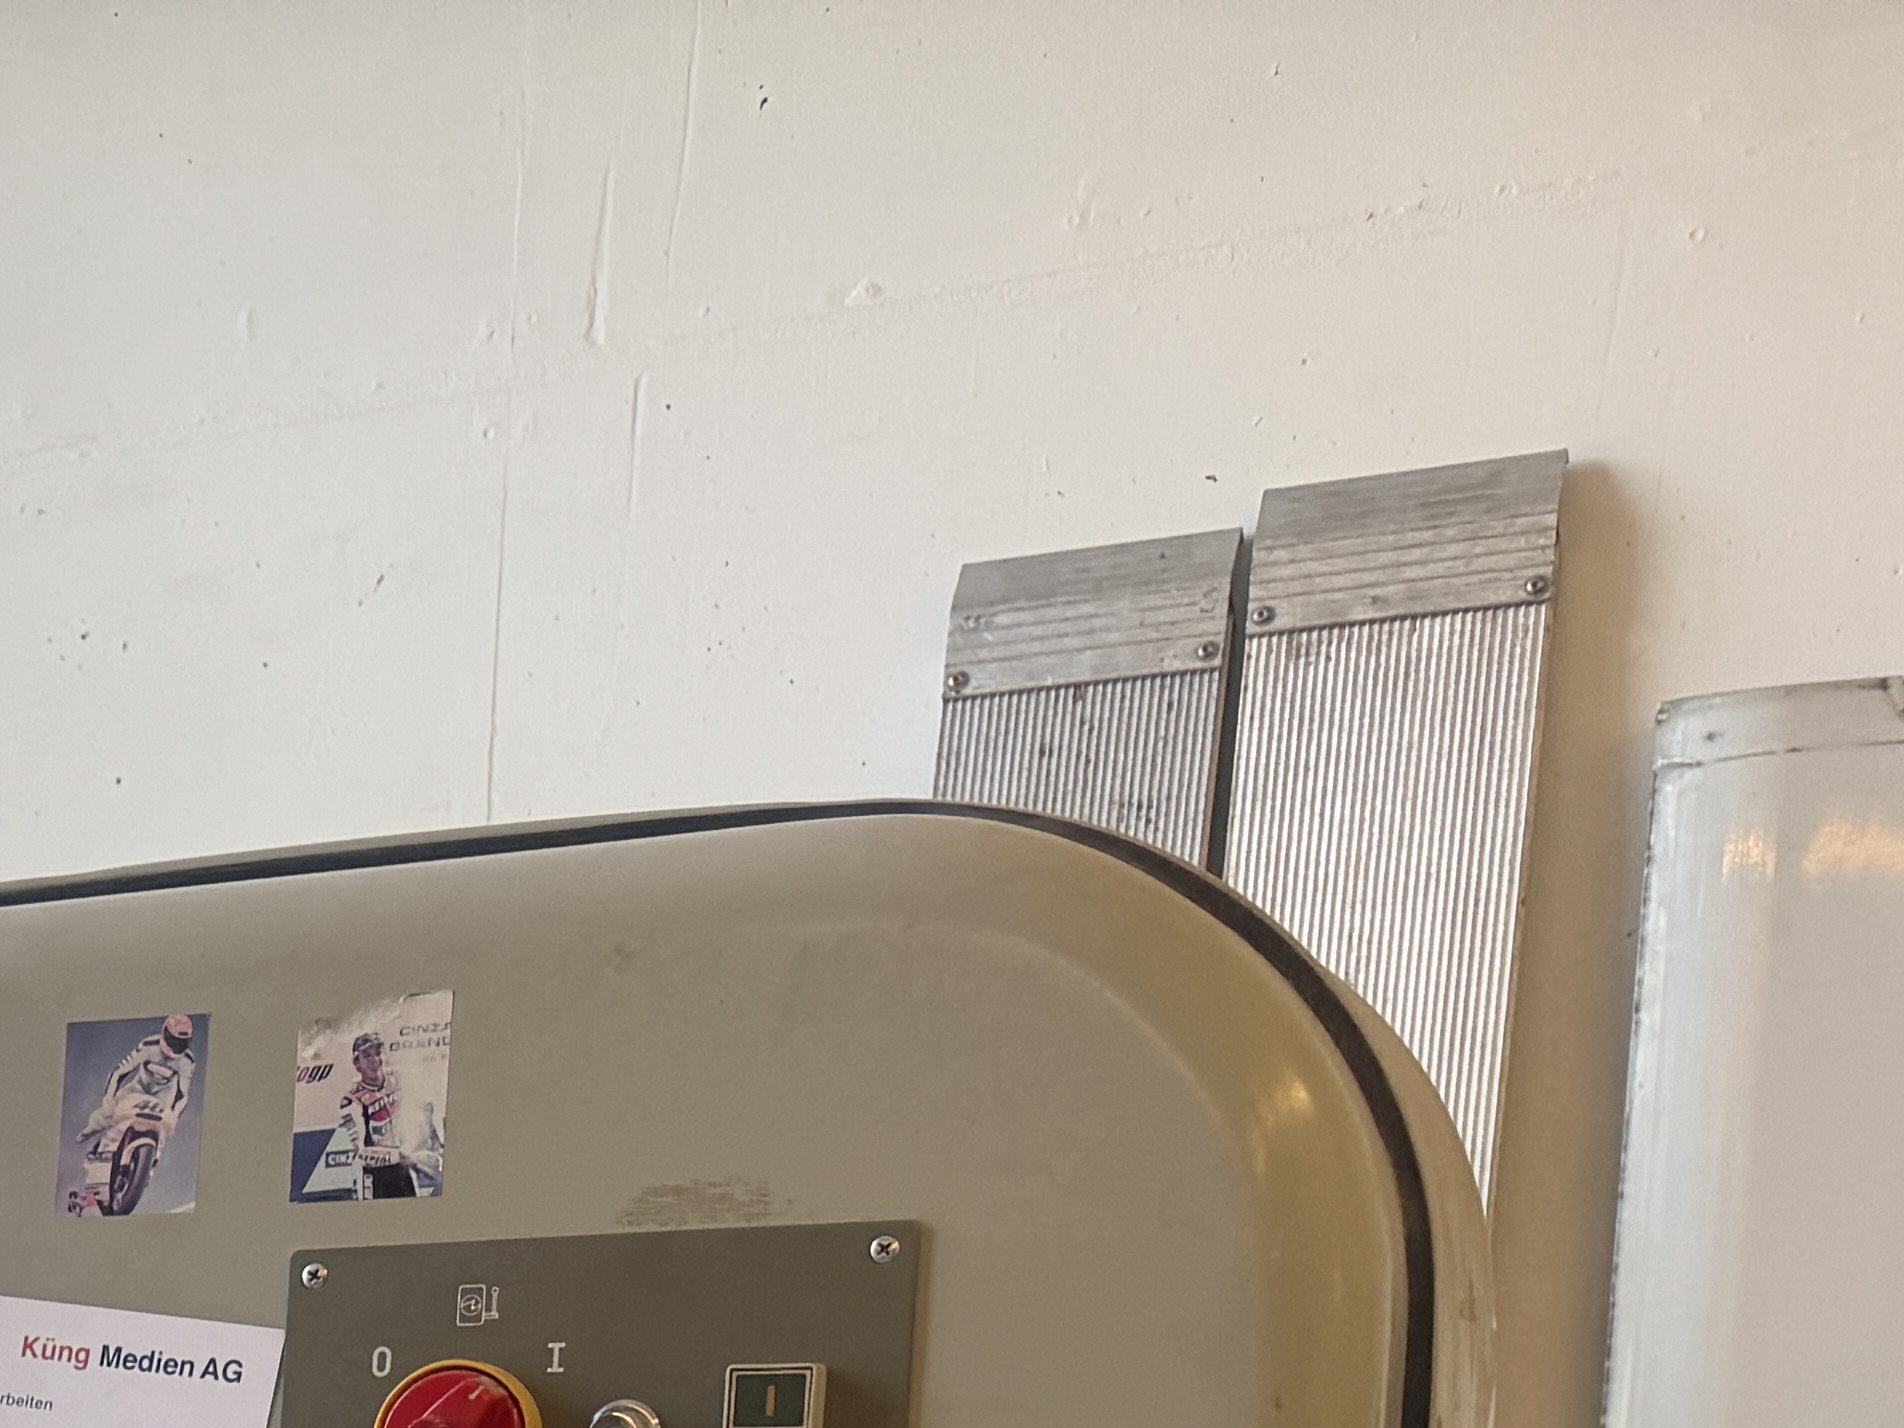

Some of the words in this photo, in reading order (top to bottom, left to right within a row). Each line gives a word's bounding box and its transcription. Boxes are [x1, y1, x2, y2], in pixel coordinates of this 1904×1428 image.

[21, 1335, 90, 1371] Küng
[99, 1344, 194, 1378] Medien
[200, 1357, 243, 1384] AG
